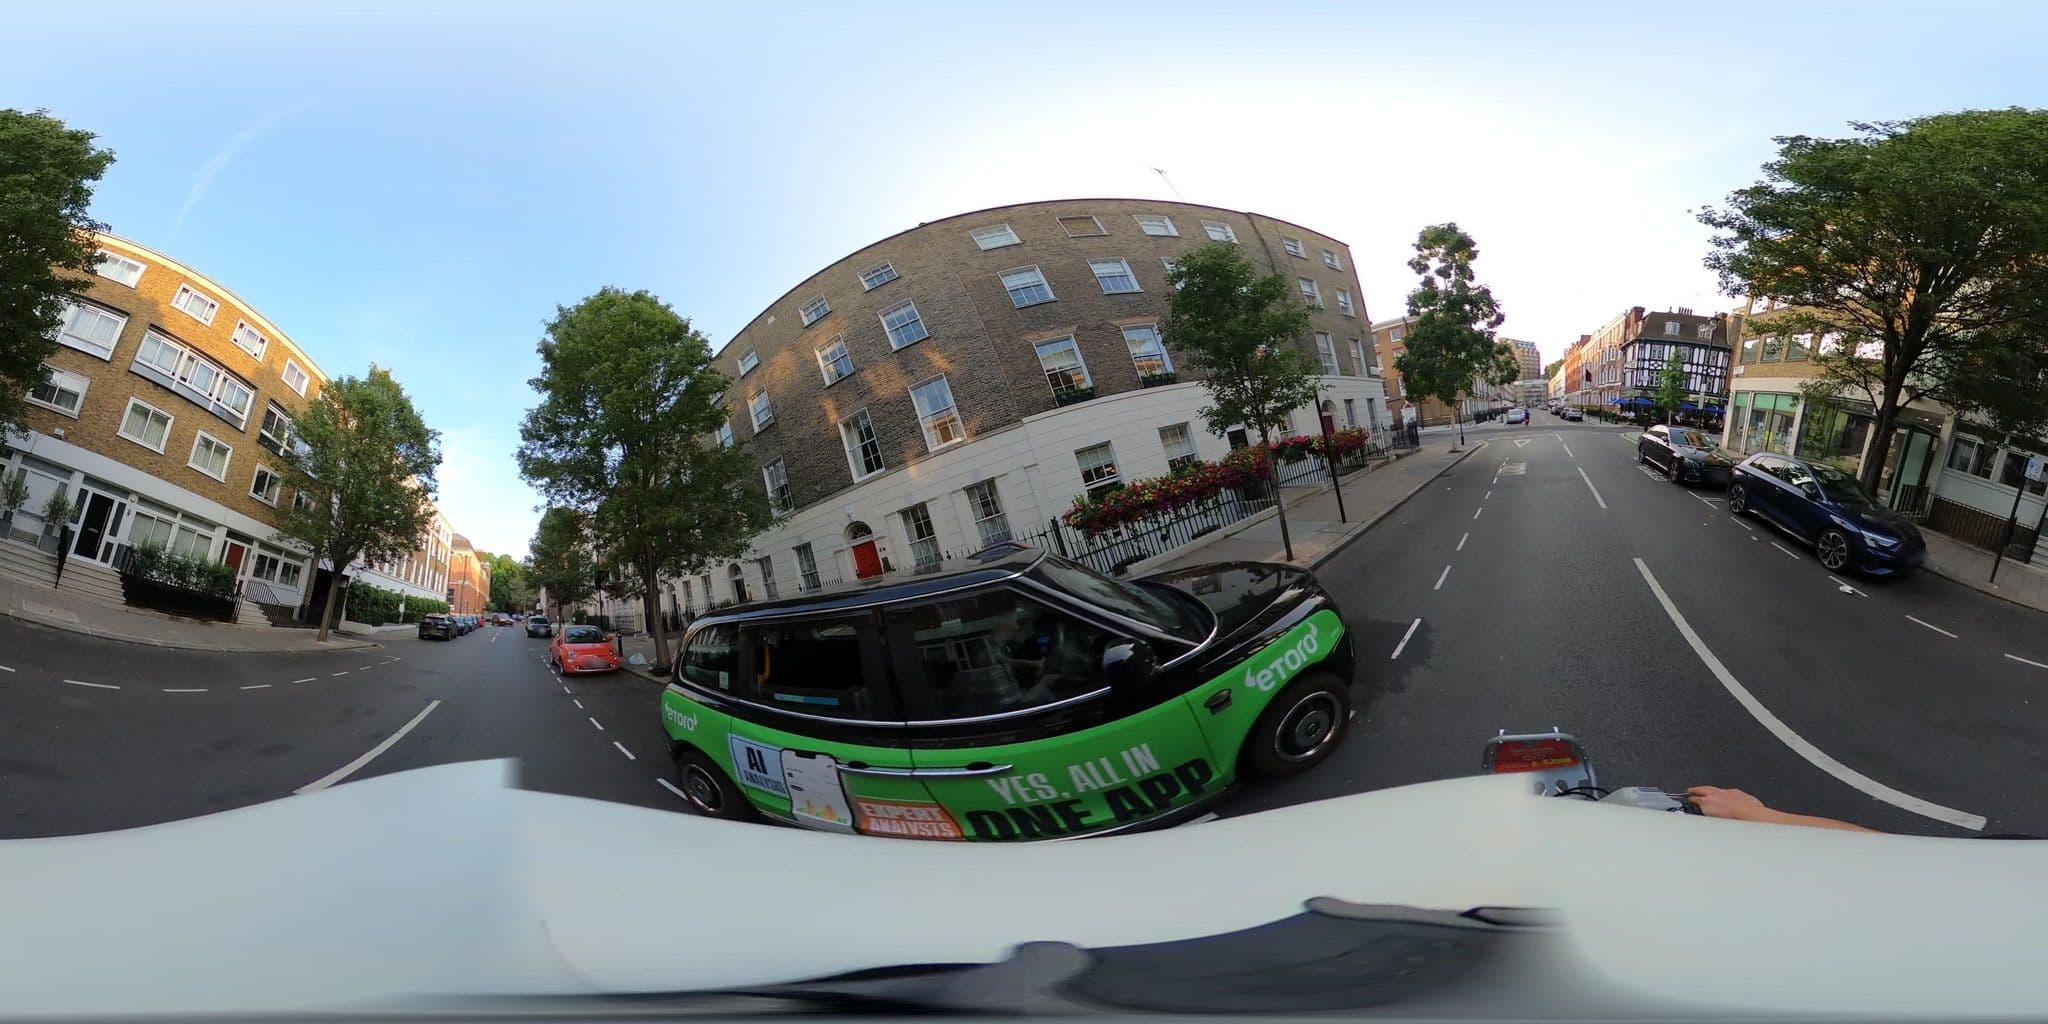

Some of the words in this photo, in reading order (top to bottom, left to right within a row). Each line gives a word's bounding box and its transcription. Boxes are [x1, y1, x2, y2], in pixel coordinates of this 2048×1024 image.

[745, 746, 768, 775] AI
[1067, 757, 1127, 793] ALL
[1121, 743, 1160, 777] IN
[859, 802, 944, 821] EXPERT
[964, 799, 1092, 839] ONE
[1103, 757, 1213, 822] APP
